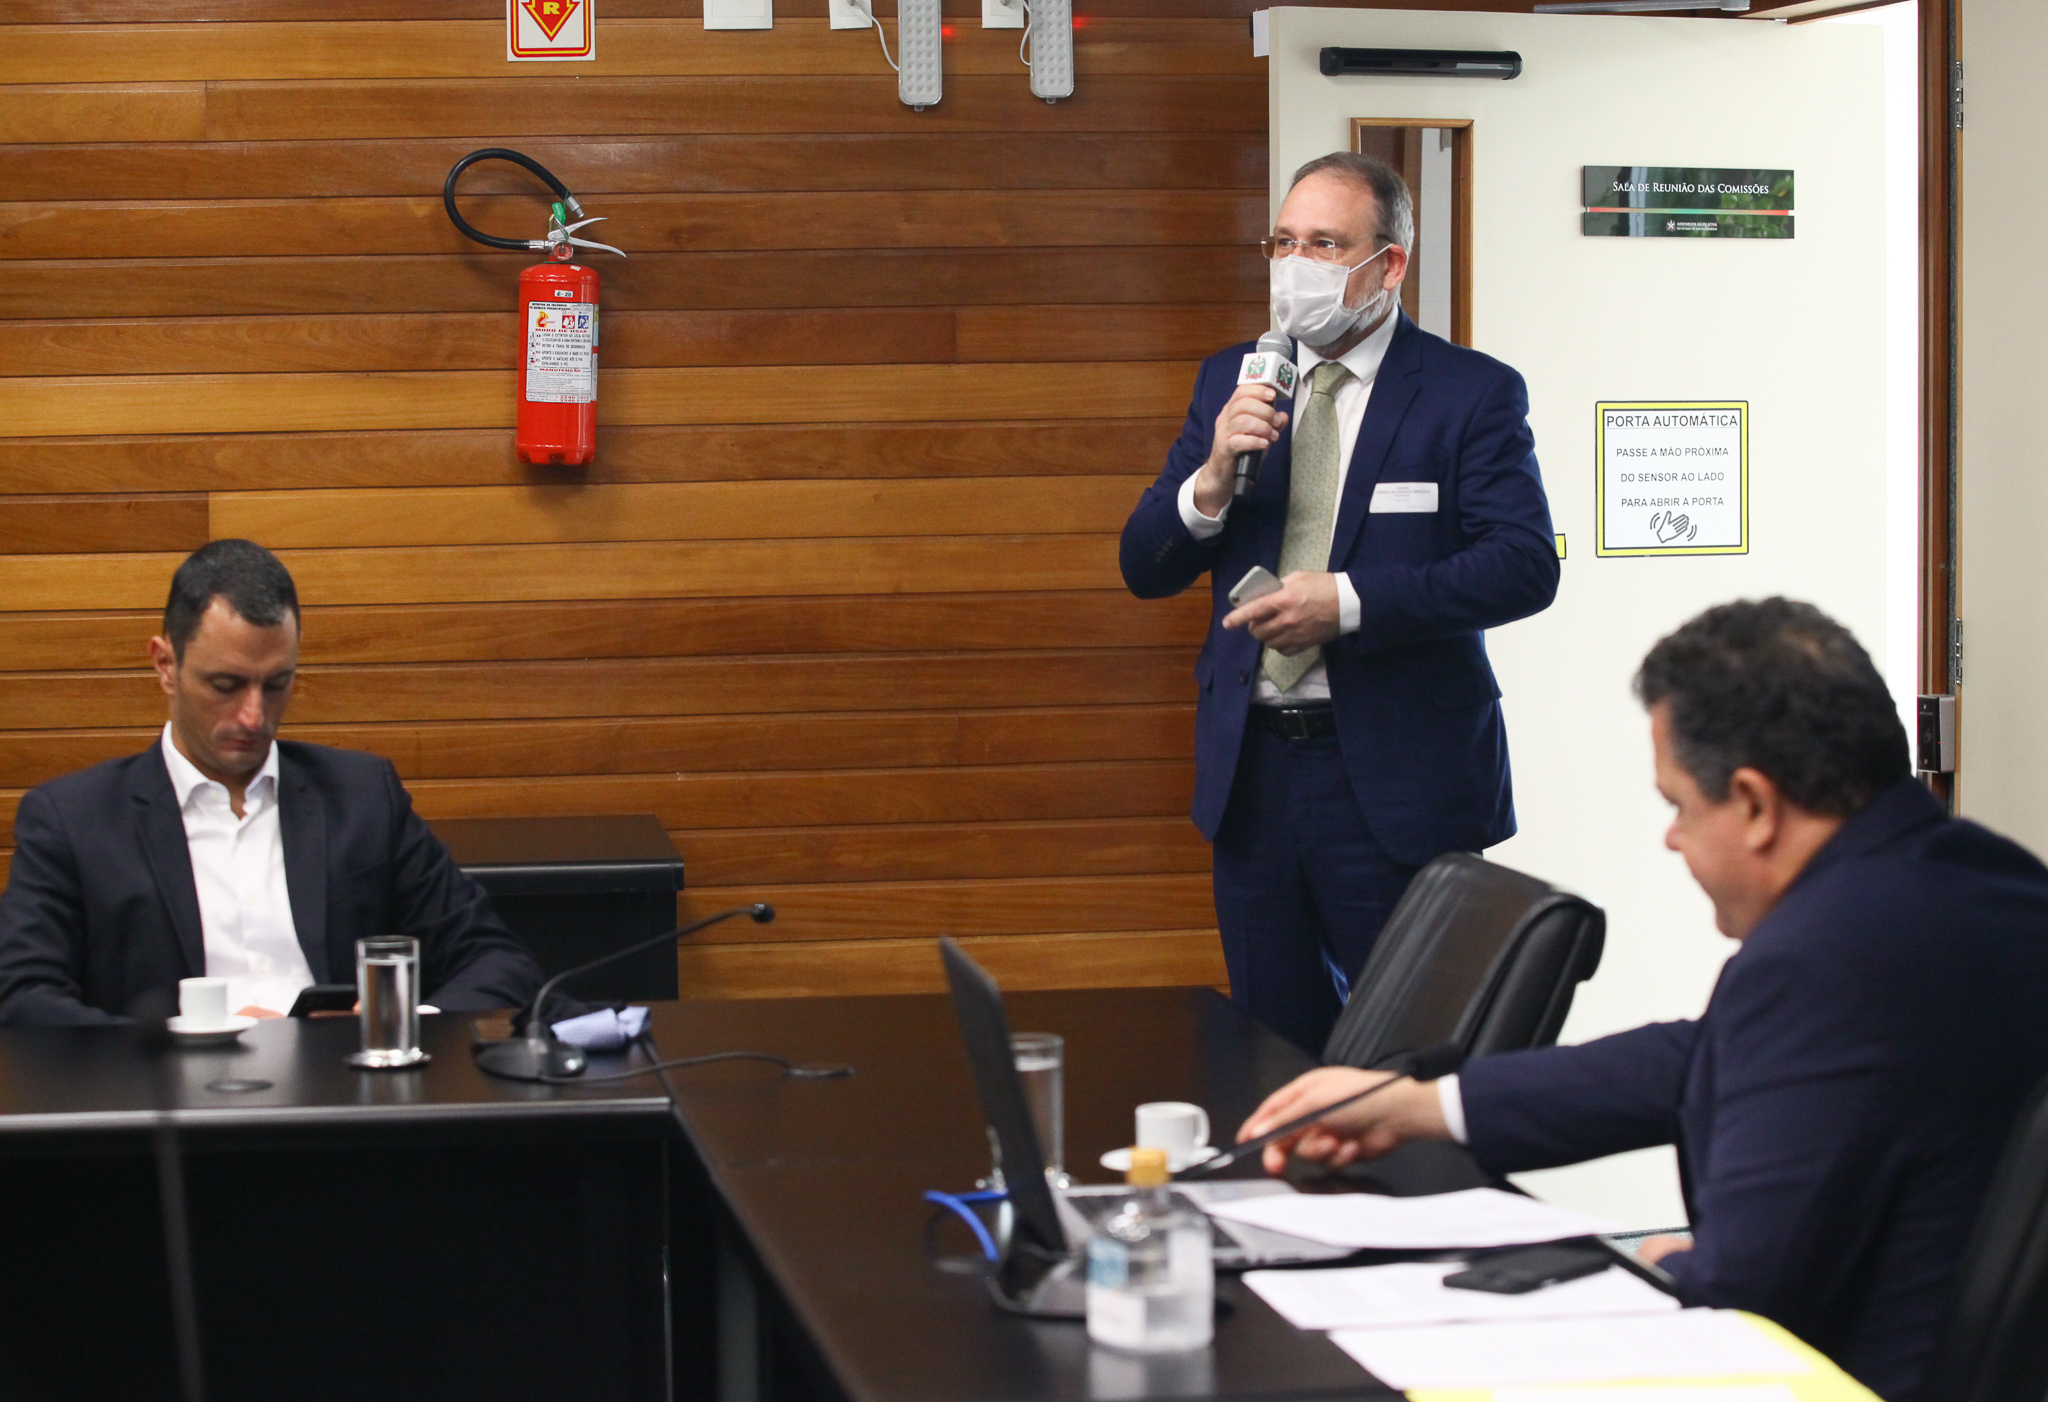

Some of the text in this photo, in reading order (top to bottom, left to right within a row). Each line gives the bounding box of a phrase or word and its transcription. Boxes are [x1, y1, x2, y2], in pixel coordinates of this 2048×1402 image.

[543, 2, 560, 14] R
[1606, 413, 1738, 427] PORTA AUTOMÁTICA
[1616, 446, 1729, 457] PASSE A MÃO PRÓXIMA
[1621, 472, 1724, 482] DO SENSOR AO LADO
[1622, 497, 1724, 507] PARA ABRIR A PORTA
